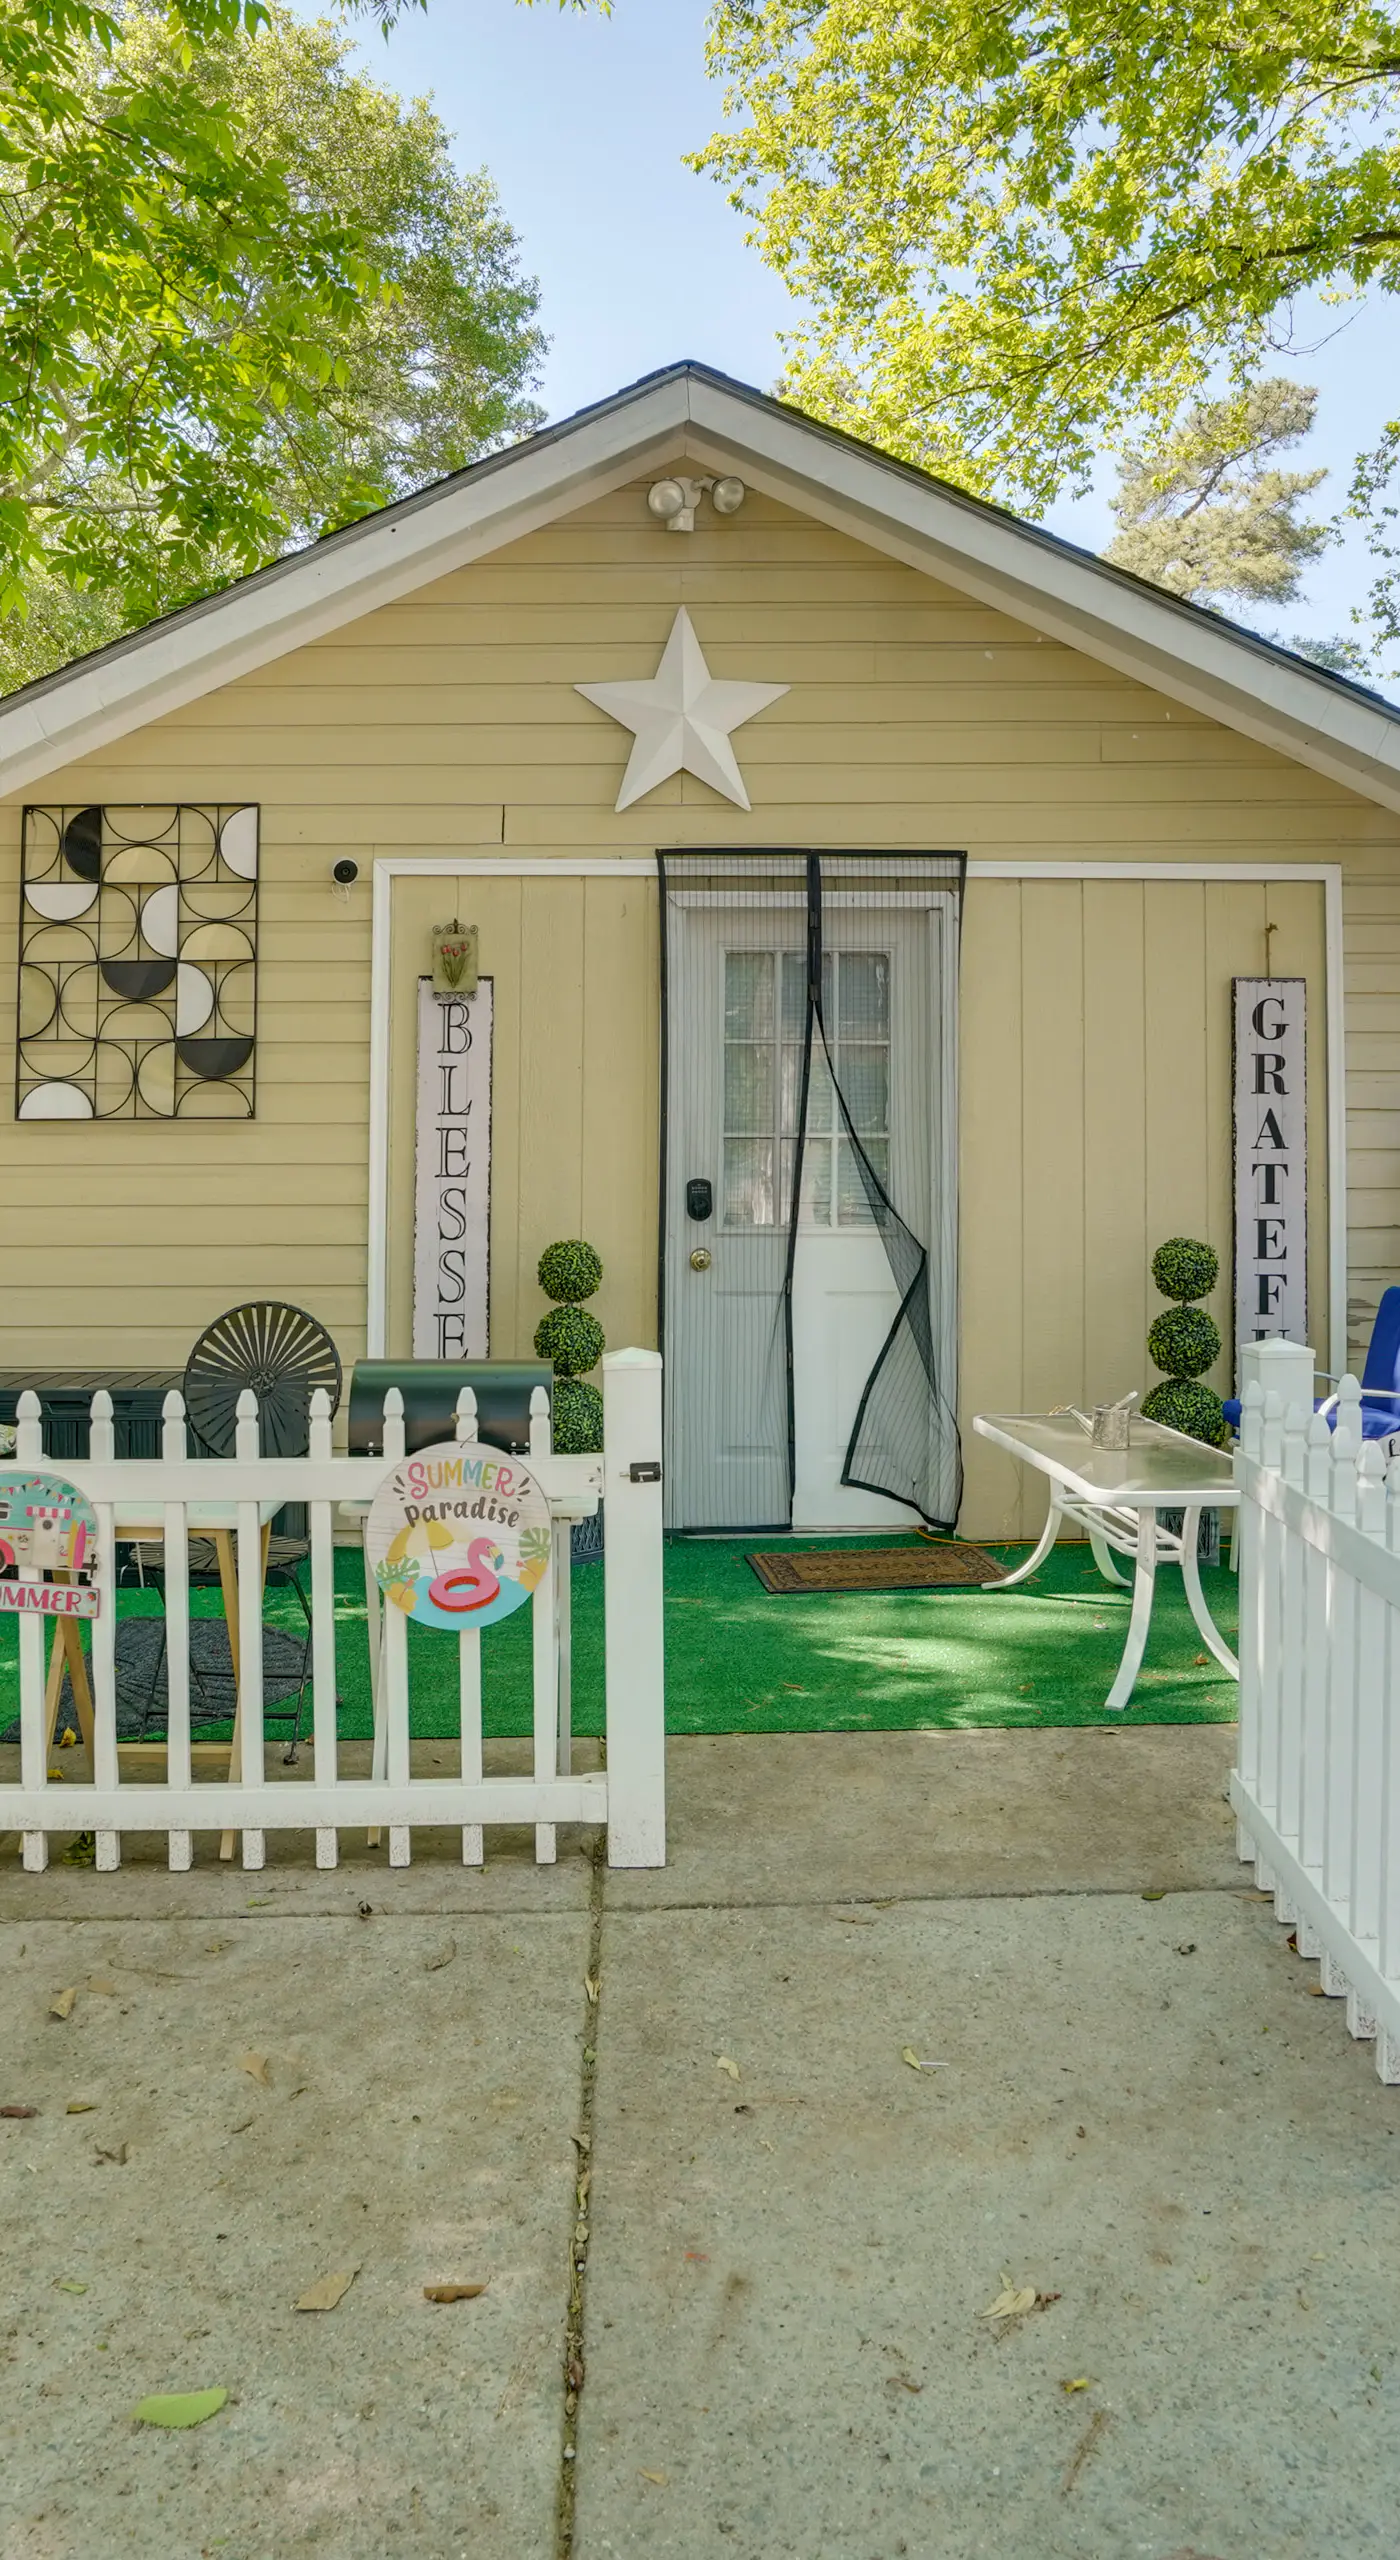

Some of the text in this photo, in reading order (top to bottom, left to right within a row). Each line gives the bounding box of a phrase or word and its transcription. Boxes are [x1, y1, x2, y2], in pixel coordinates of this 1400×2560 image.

[407, 1458, 515, 1500] SUMMER
[404, 1496, 520, 1528] paradise
[0, 1586, 81, 1612] MMER
